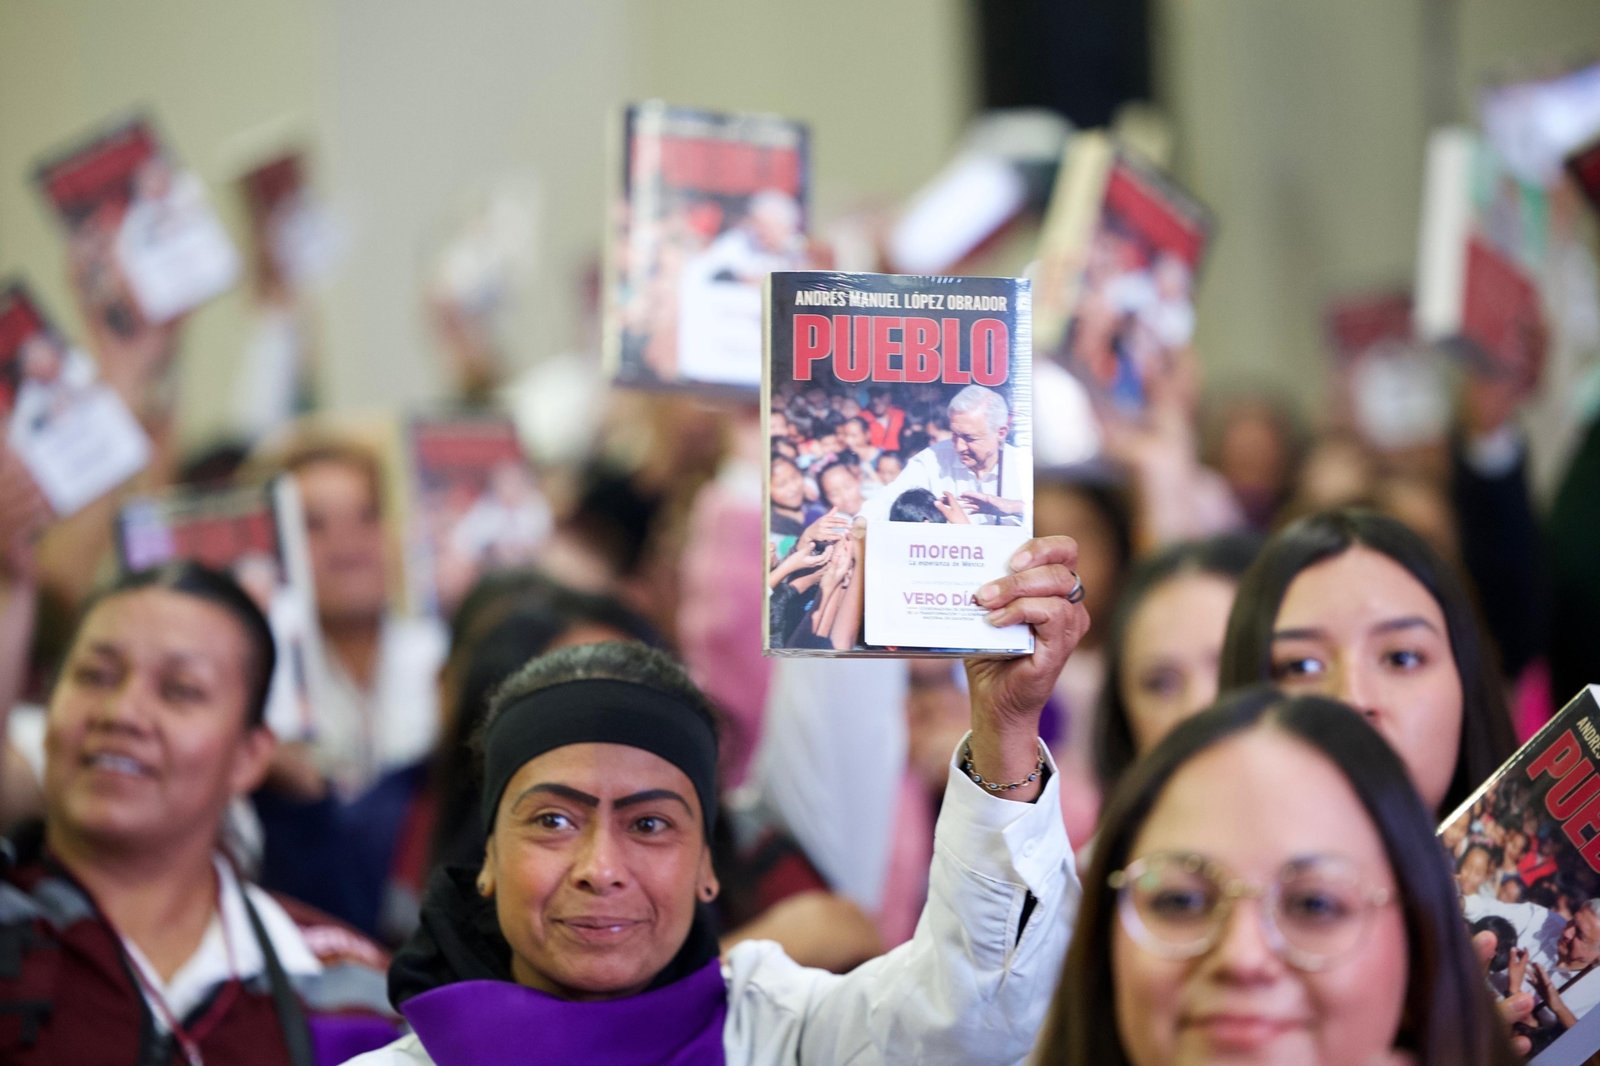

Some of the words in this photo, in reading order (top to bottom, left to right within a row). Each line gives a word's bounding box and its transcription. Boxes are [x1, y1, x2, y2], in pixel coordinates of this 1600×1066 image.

[795, 288, 847, 307] ANDRÉS
[850, 290, 901, 309] MANUEL
[904, 291, 945, 310] LÓPEZ
[947, 294, 1008, 312] OBRADOR
[793, 313, 1010, 387] PUEBLO
[909, 544, 984, 560] morena
[903, 591, 947, 606] VERO
[952, 590, 982, 606] DÍA
